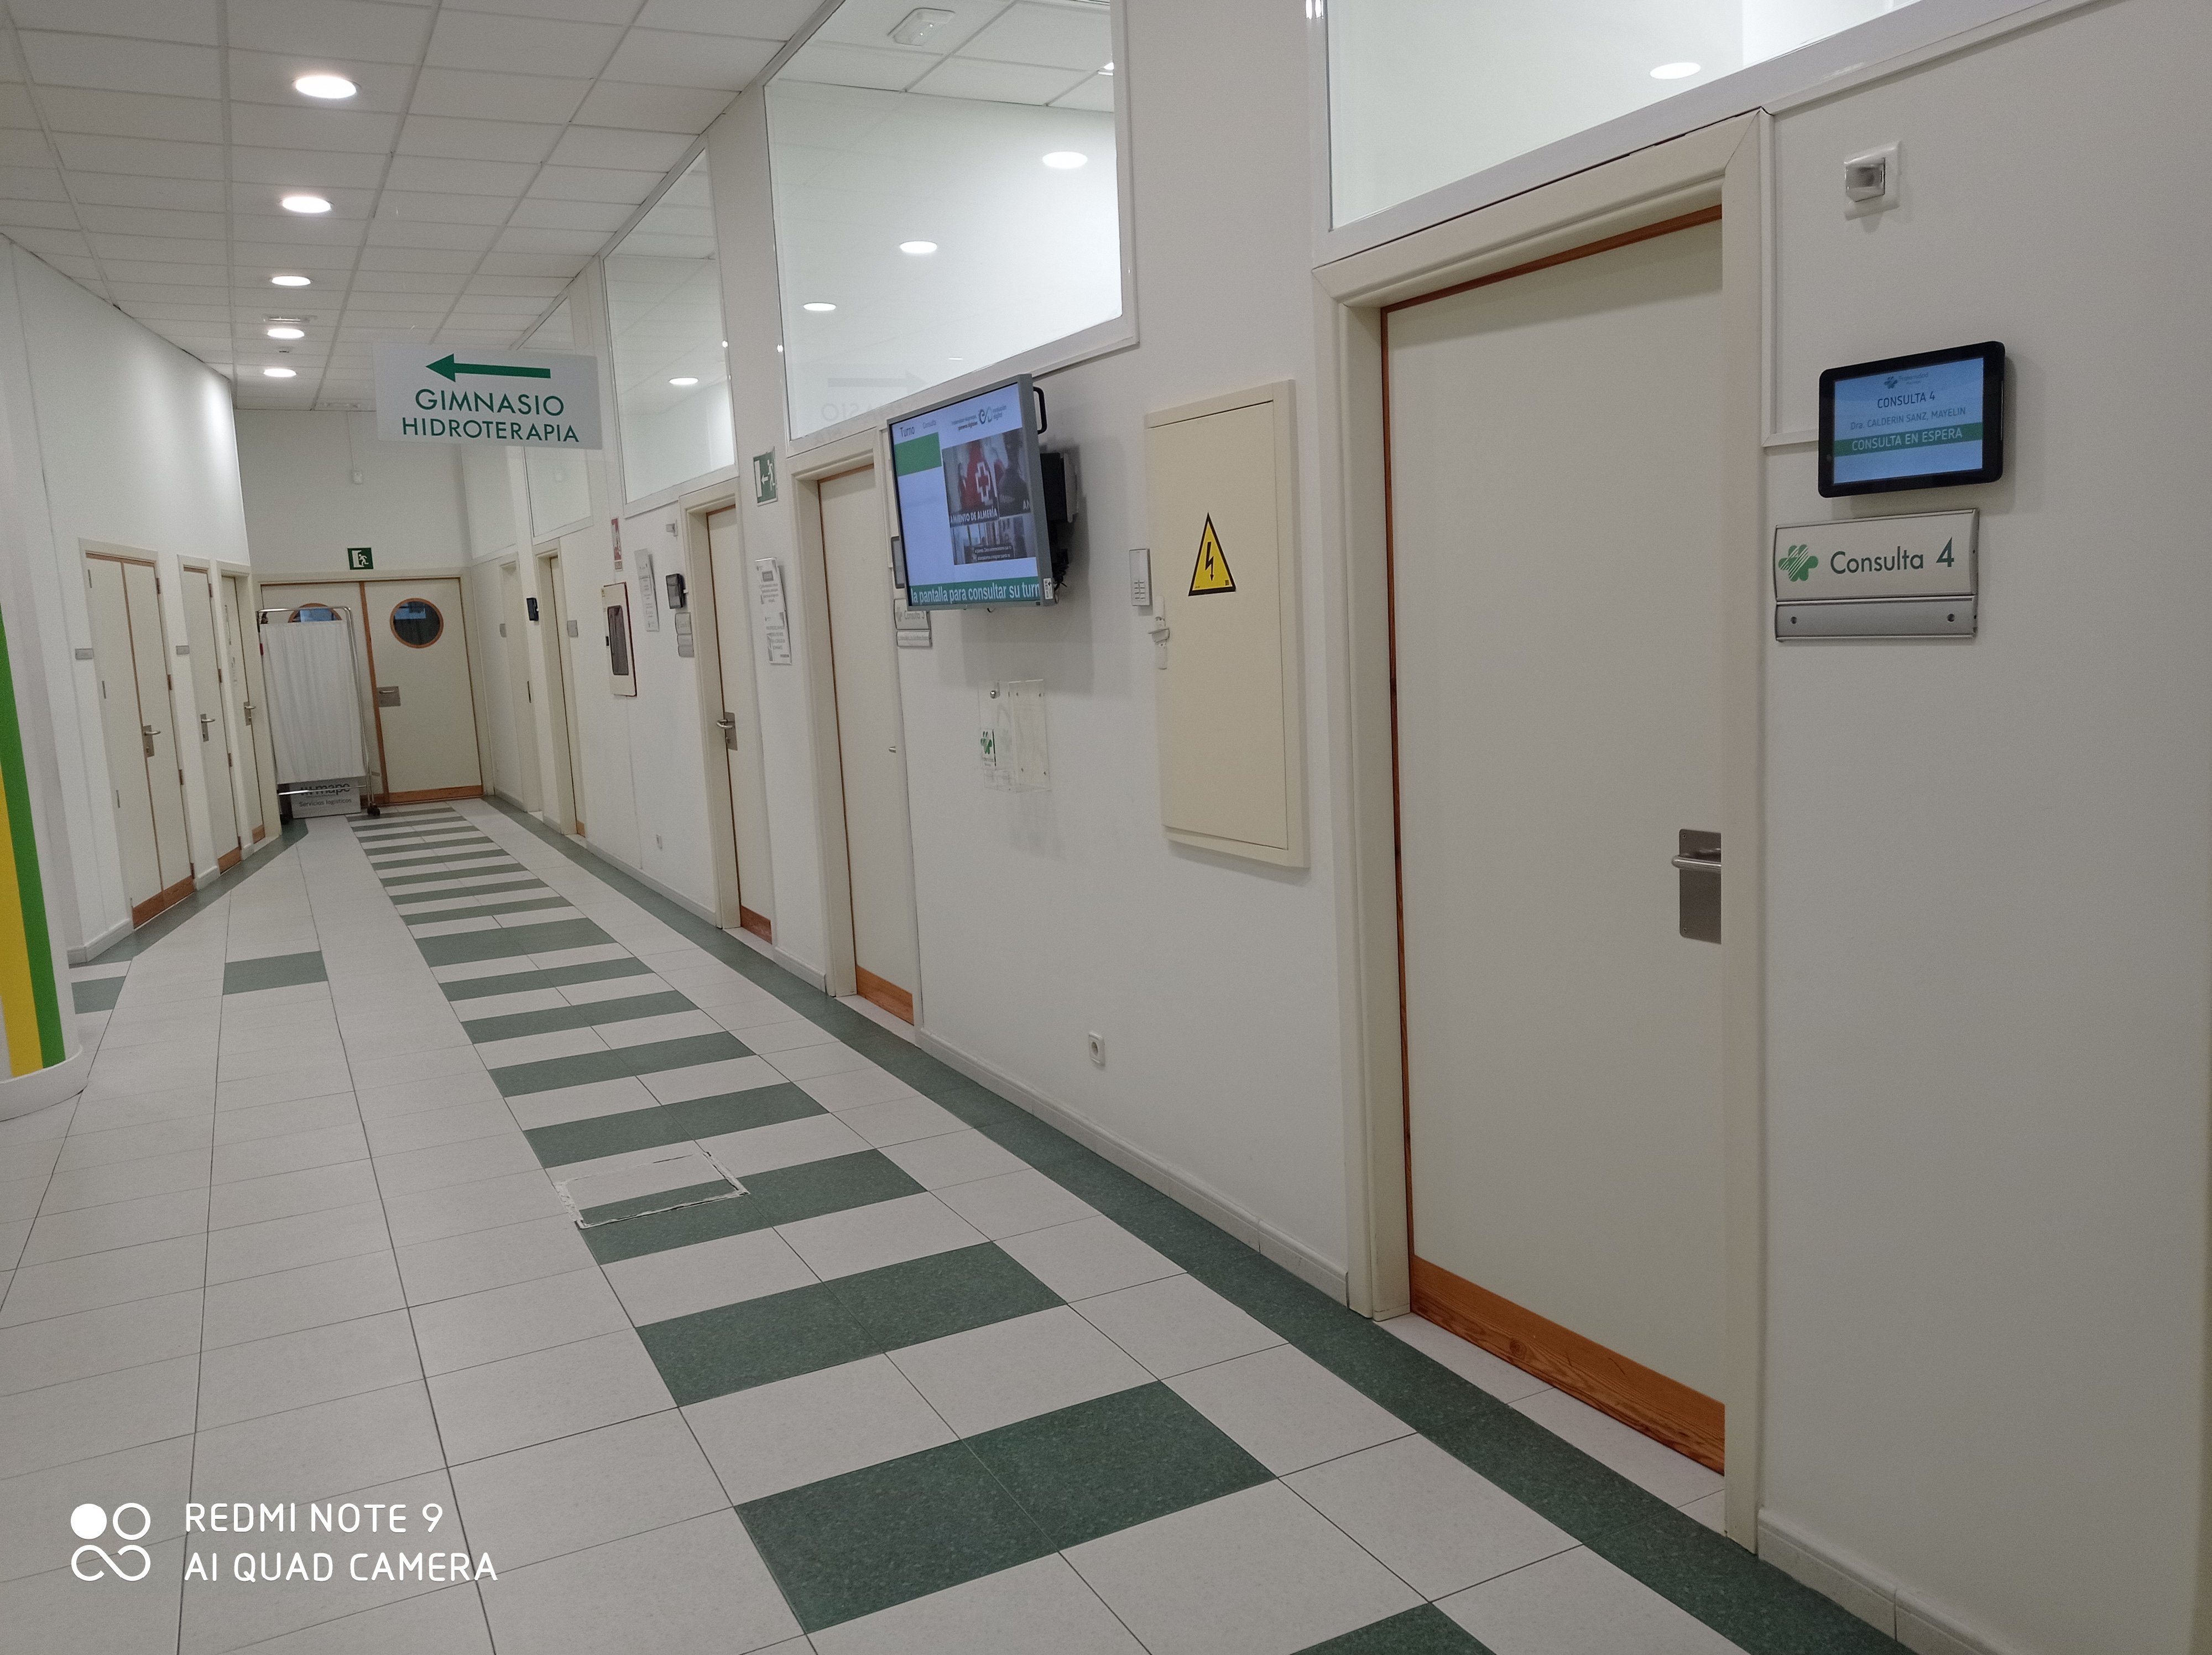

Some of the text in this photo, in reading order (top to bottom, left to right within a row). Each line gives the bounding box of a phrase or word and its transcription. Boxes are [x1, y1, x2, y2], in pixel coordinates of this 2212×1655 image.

[415, 389, 564, 416] GIMNASIO
[1877, 391, 1936, 408] CONSULTA 4
[1850, 407, 1966, 430] Dra. CALDERIN SANZ, MAYELIN
[402, 418, 579, 443] HIDROTERAPIA
[900, 426, 915, 438] Turno
[1851, 427, 1963, 451] CONSULTA EN ESPERA
[971, 513, 977, 521] DE
[977, 506, 998, 519] ALMERÍA
[1830, 536, 1955, 575] Consulta 4
[911, 588, 918, 603] la
[920, 586, 948, 605] pantalla
[950, 589, 967, 604] para
[968, 582, 1006, 600] consultar
[1009, 585, 1020, 598] su
